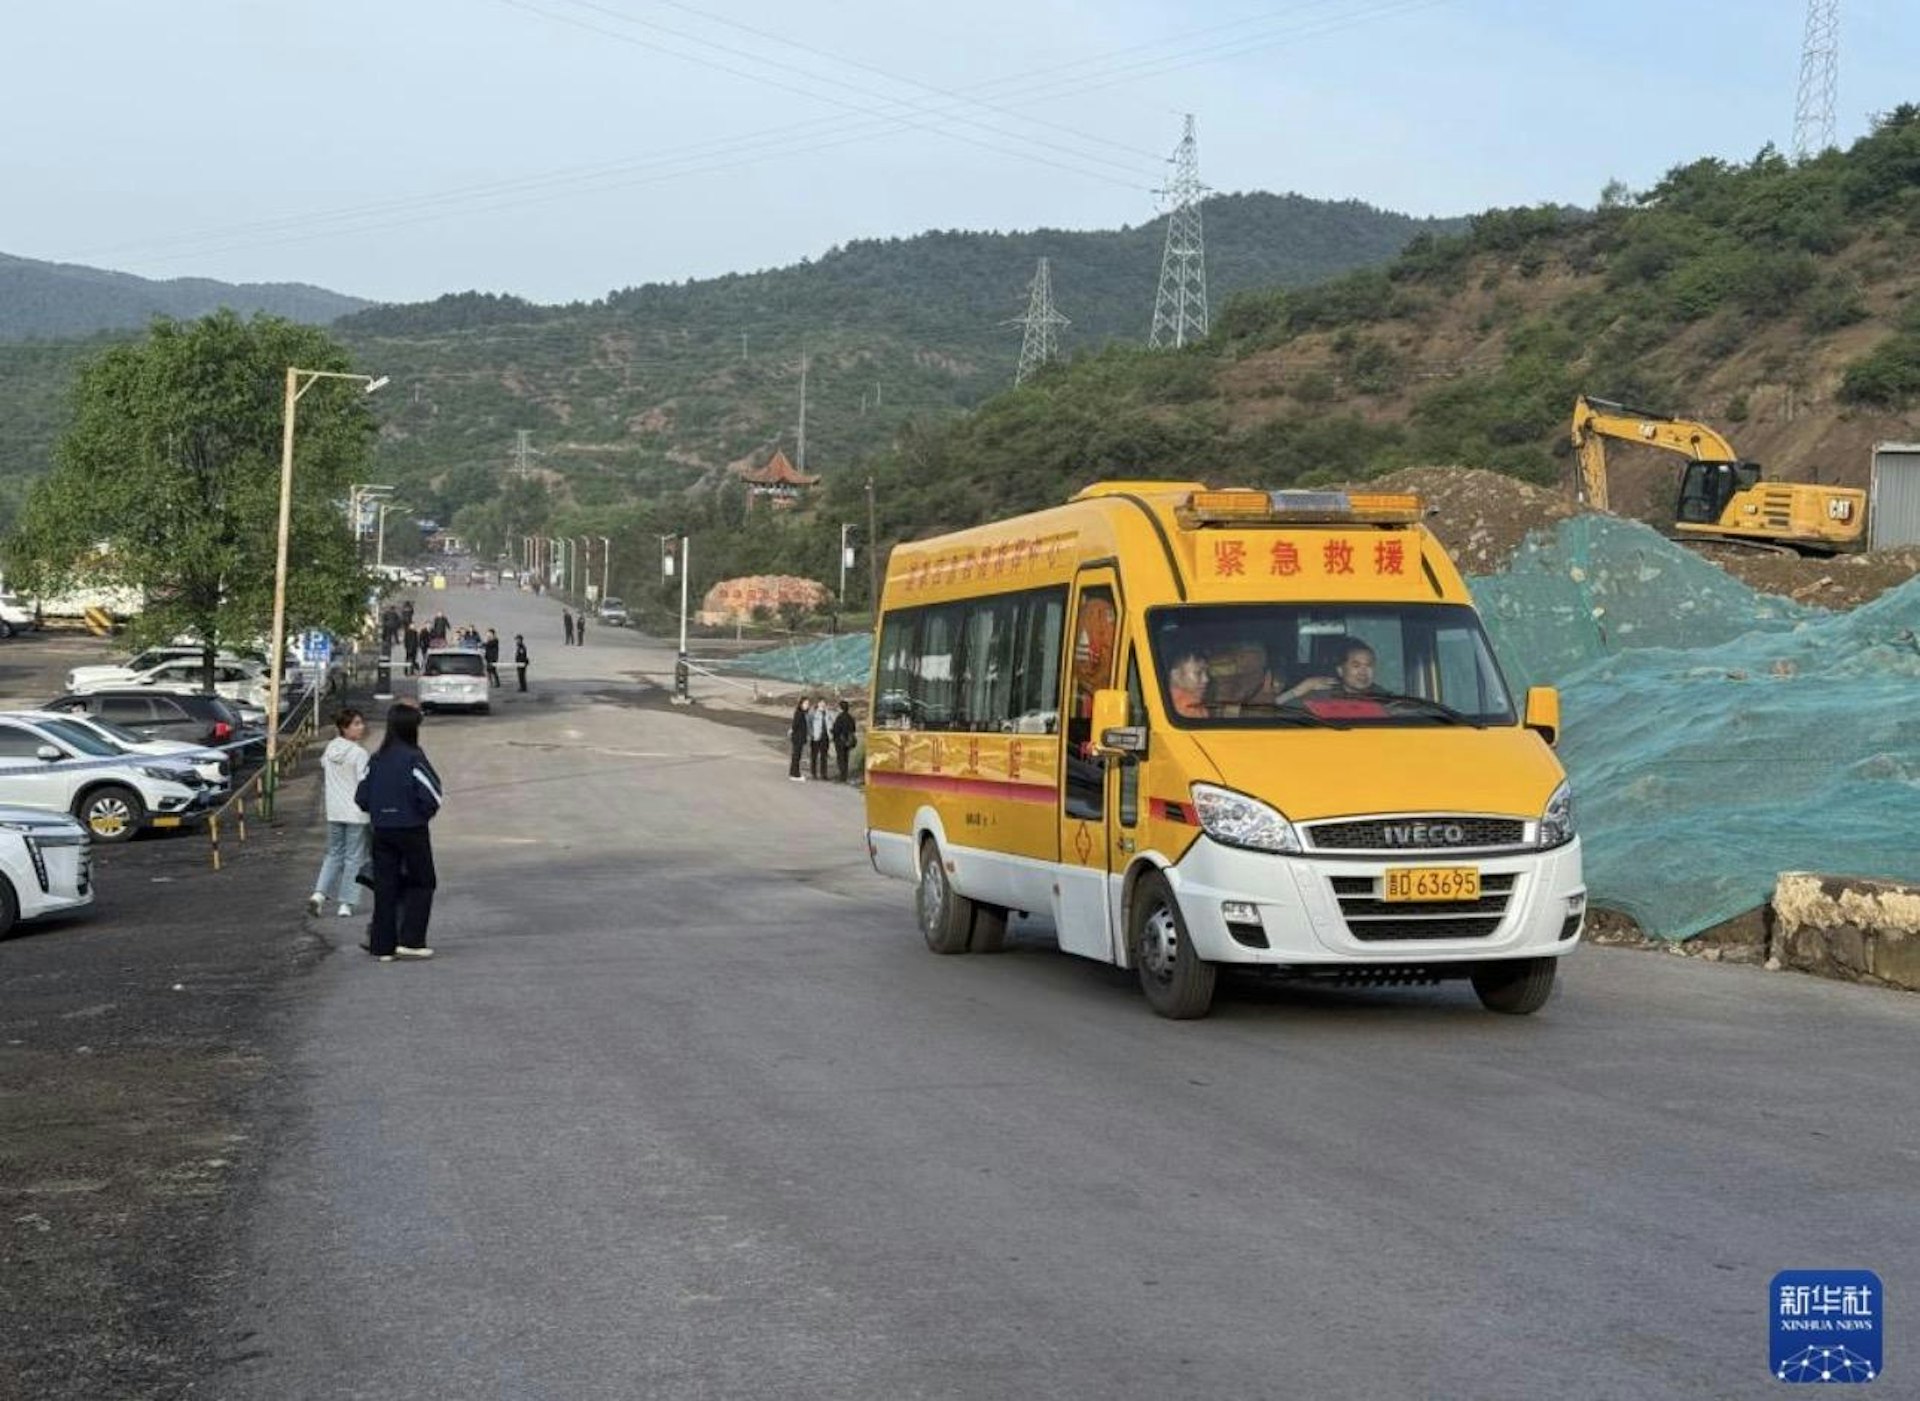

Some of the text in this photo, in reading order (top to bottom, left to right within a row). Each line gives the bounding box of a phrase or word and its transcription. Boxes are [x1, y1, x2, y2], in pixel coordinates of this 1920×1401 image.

[1829, 499, 1850, 520] CAT
[1214, 539, 1404, 577] 紧急救援
[1384, 824, 1464, 844] IVECO
